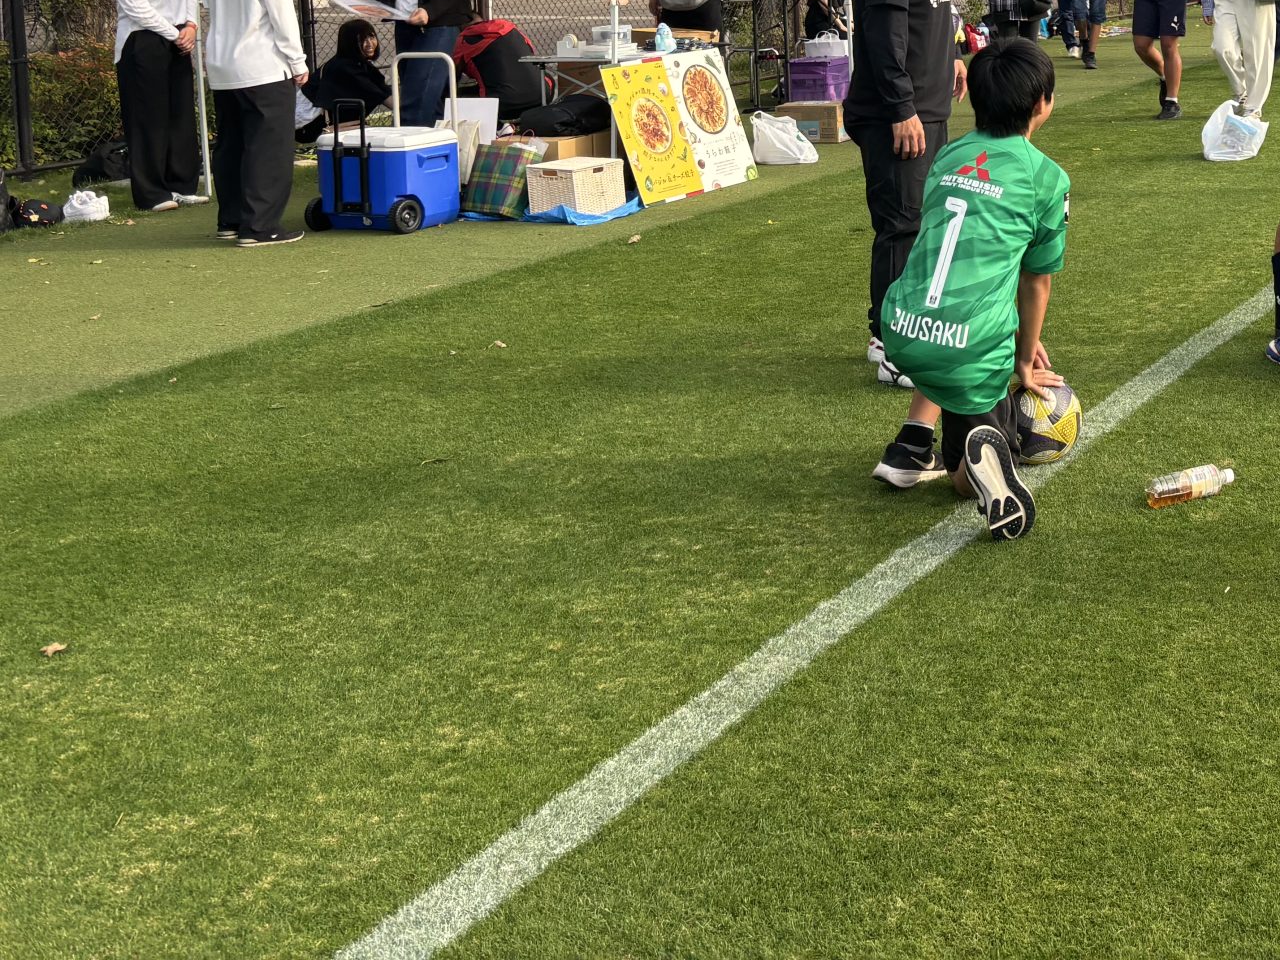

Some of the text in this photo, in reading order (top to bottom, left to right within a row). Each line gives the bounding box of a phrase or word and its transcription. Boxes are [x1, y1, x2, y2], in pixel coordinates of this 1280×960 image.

[942, 175, 1004, 195] MITSUBISHI
[959, 183, 1002, 199] INDUSTRIES
[925, 196, 968, 308] 1
[890, 308, 969, 349] SHUSAKU
